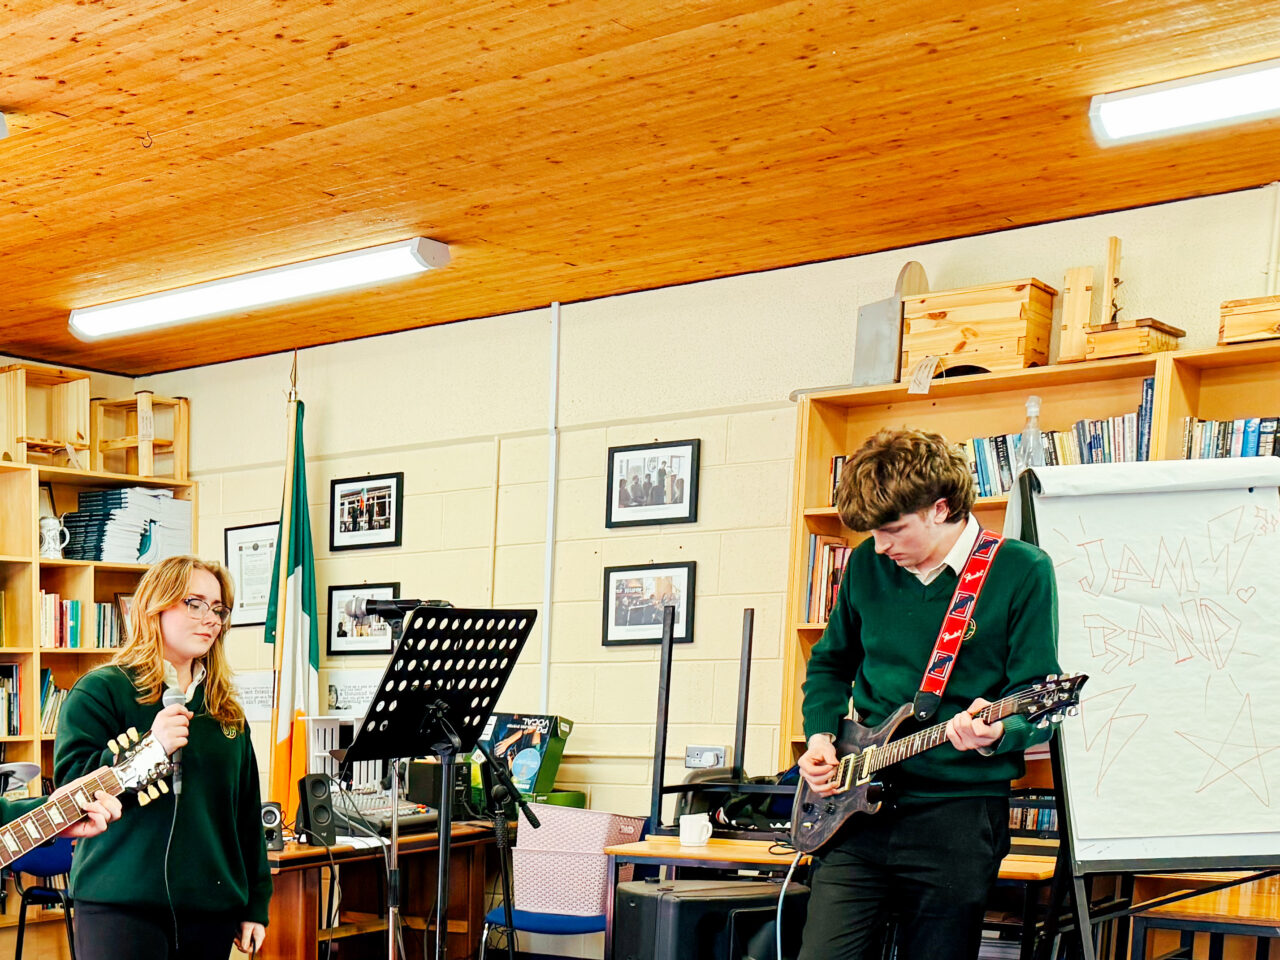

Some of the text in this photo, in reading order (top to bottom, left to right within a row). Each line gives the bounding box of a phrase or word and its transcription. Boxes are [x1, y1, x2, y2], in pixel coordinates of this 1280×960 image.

[1077, 536, 1200, 598] JAM
[1082, 597, 1242, 674] BAND
[522, 718, 549, 726] VOCAL
